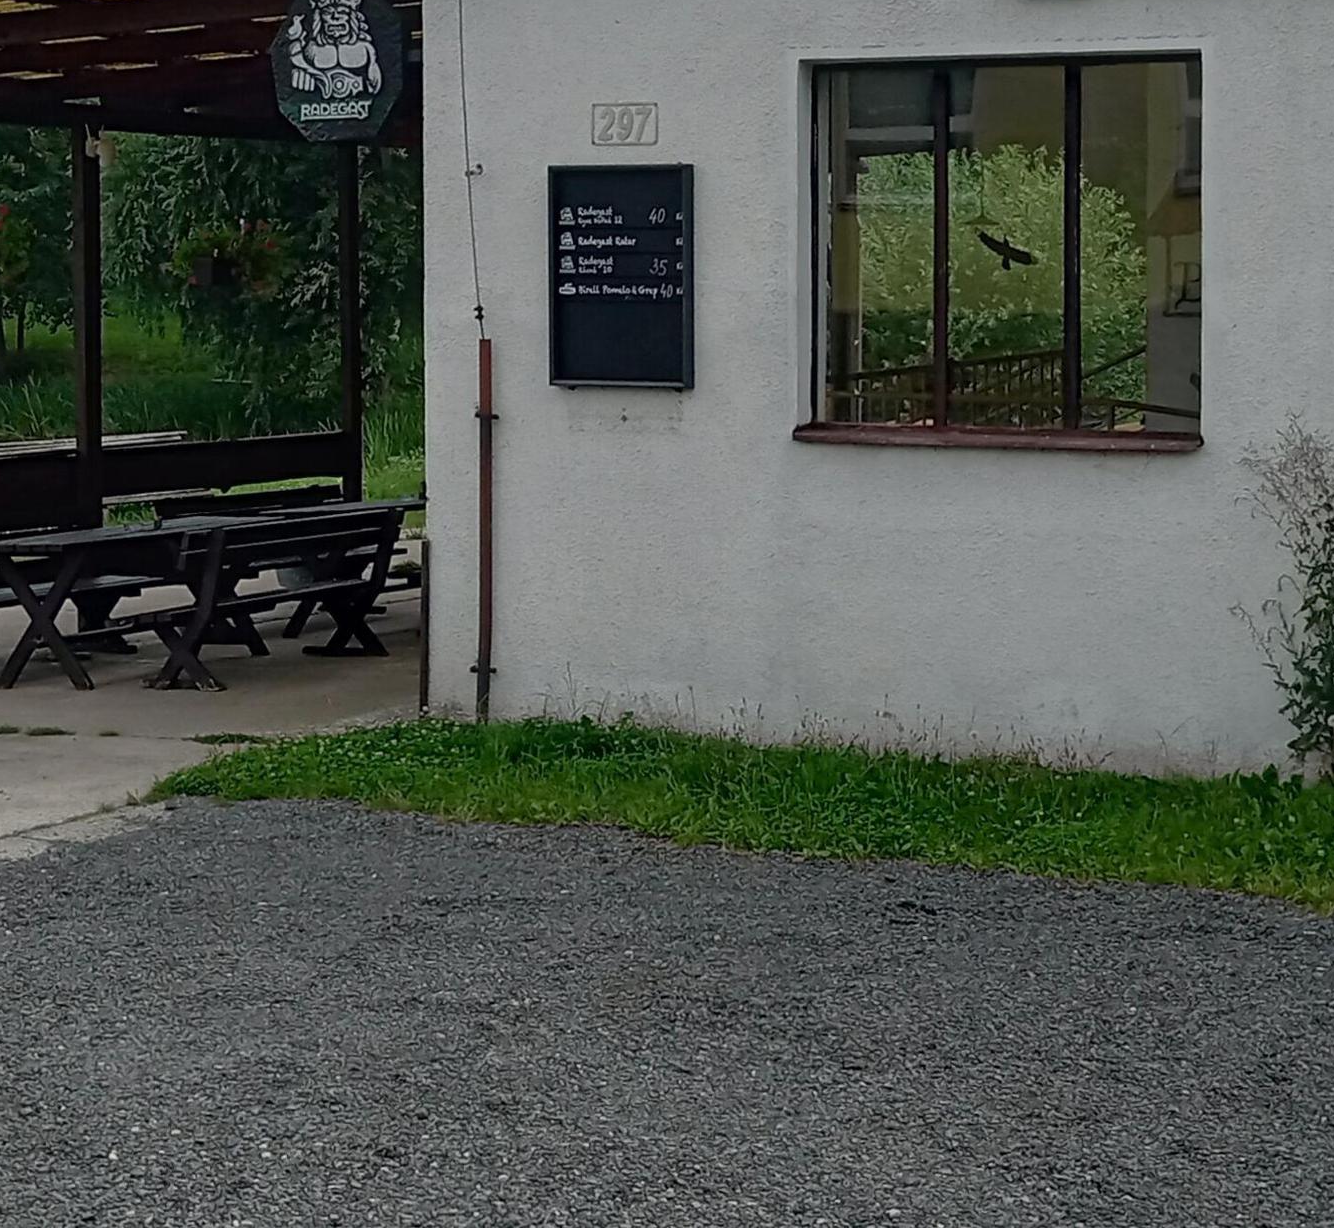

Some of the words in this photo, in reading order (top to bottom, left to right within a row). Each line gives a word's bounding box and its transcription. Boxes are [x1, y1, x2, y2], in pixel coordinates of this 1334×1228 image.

[300, 100, 371, 121] RADEGAST
[598, 106, 653, 142] 297
[648, 207, 666, 224] 40
[649, 258, 668, 276] 35
